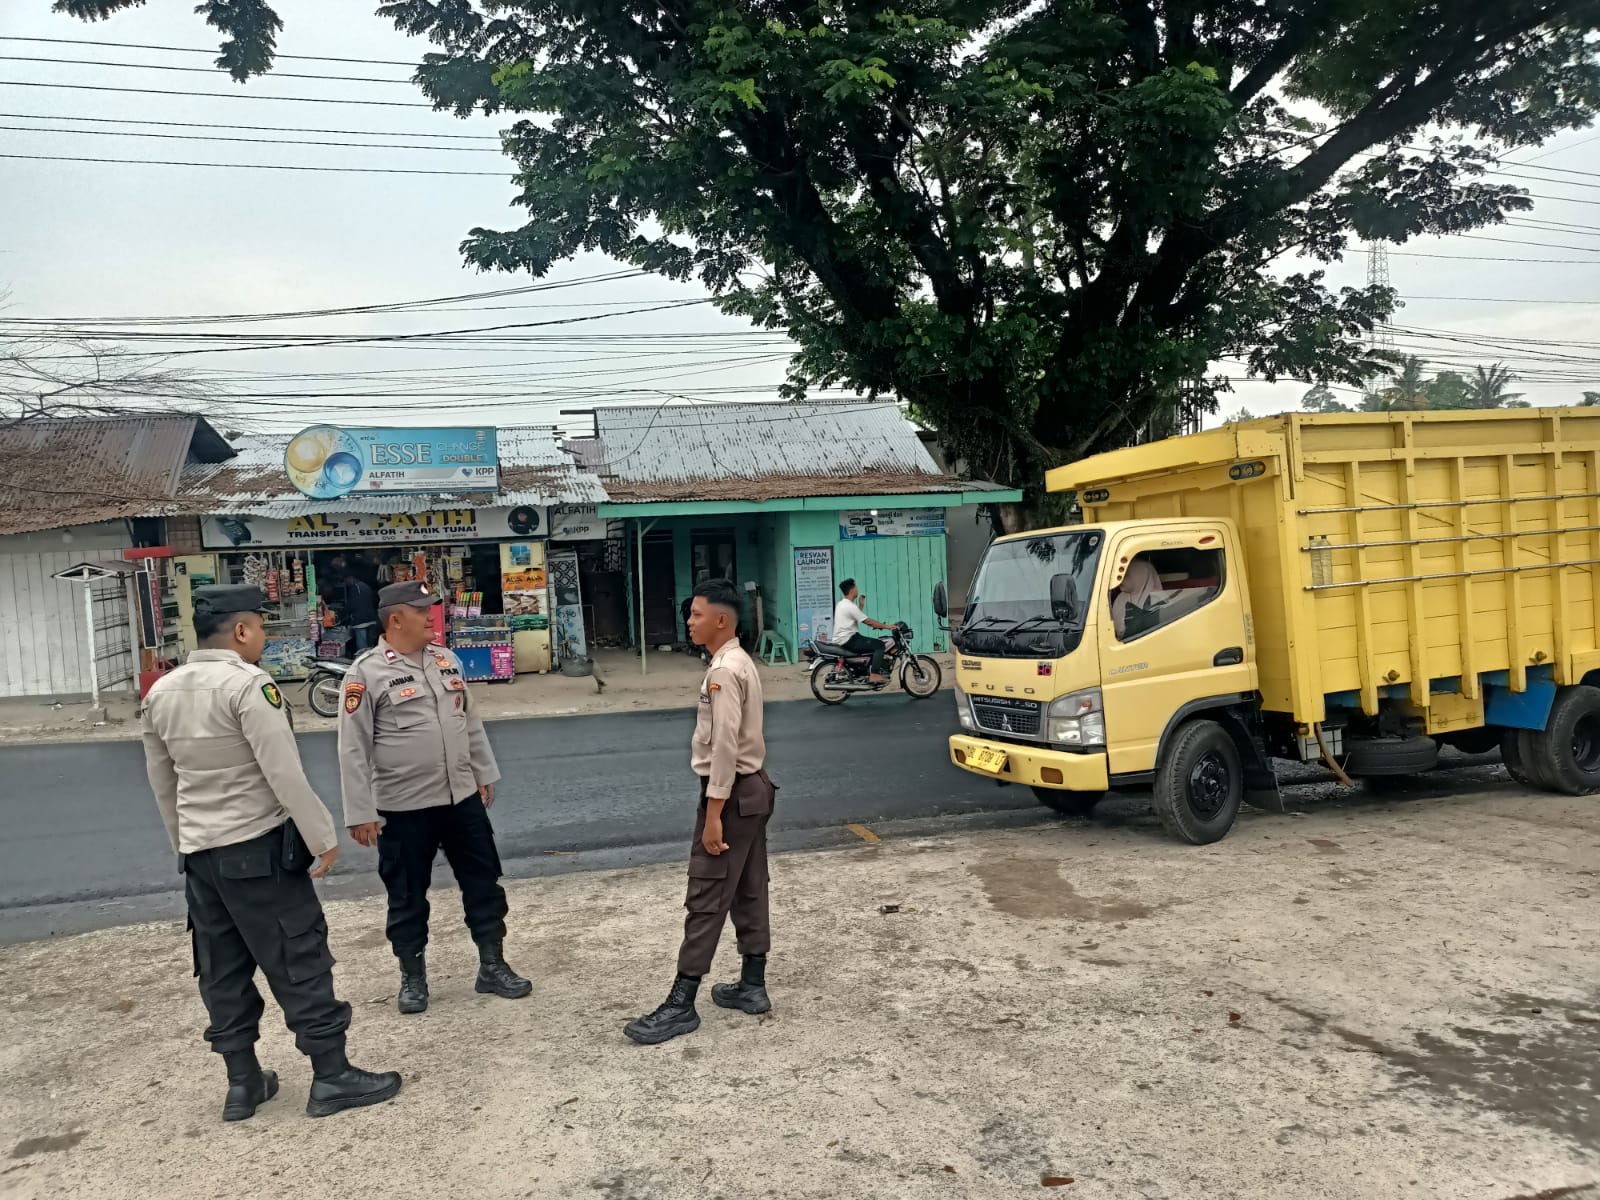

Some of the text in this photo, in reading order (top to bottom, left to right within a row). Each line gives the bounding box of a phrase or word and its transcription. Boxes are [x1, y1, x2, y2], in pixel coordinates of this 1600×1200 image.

[370, 441, 487, 466] ESSE CHANGE
[442, 454, 483, 463] DOUBLE
[368, 471, 405, 479] ALFATIH
[475, 467, 494, 476] KPP
[554, 503, 596, 515] ALFATIH
[287, 530, 348, 538] TRANSFER
[358, 528, 396, 536] SETOR
[442, 525, 477, 533] TUNAI
[573, 526, 590, 535] KPP
[799, 551, 827, 559] RESVAN
[797, 558, 830, 566] LAUNDRY
[971, 682, 1036, 694] FUSO
